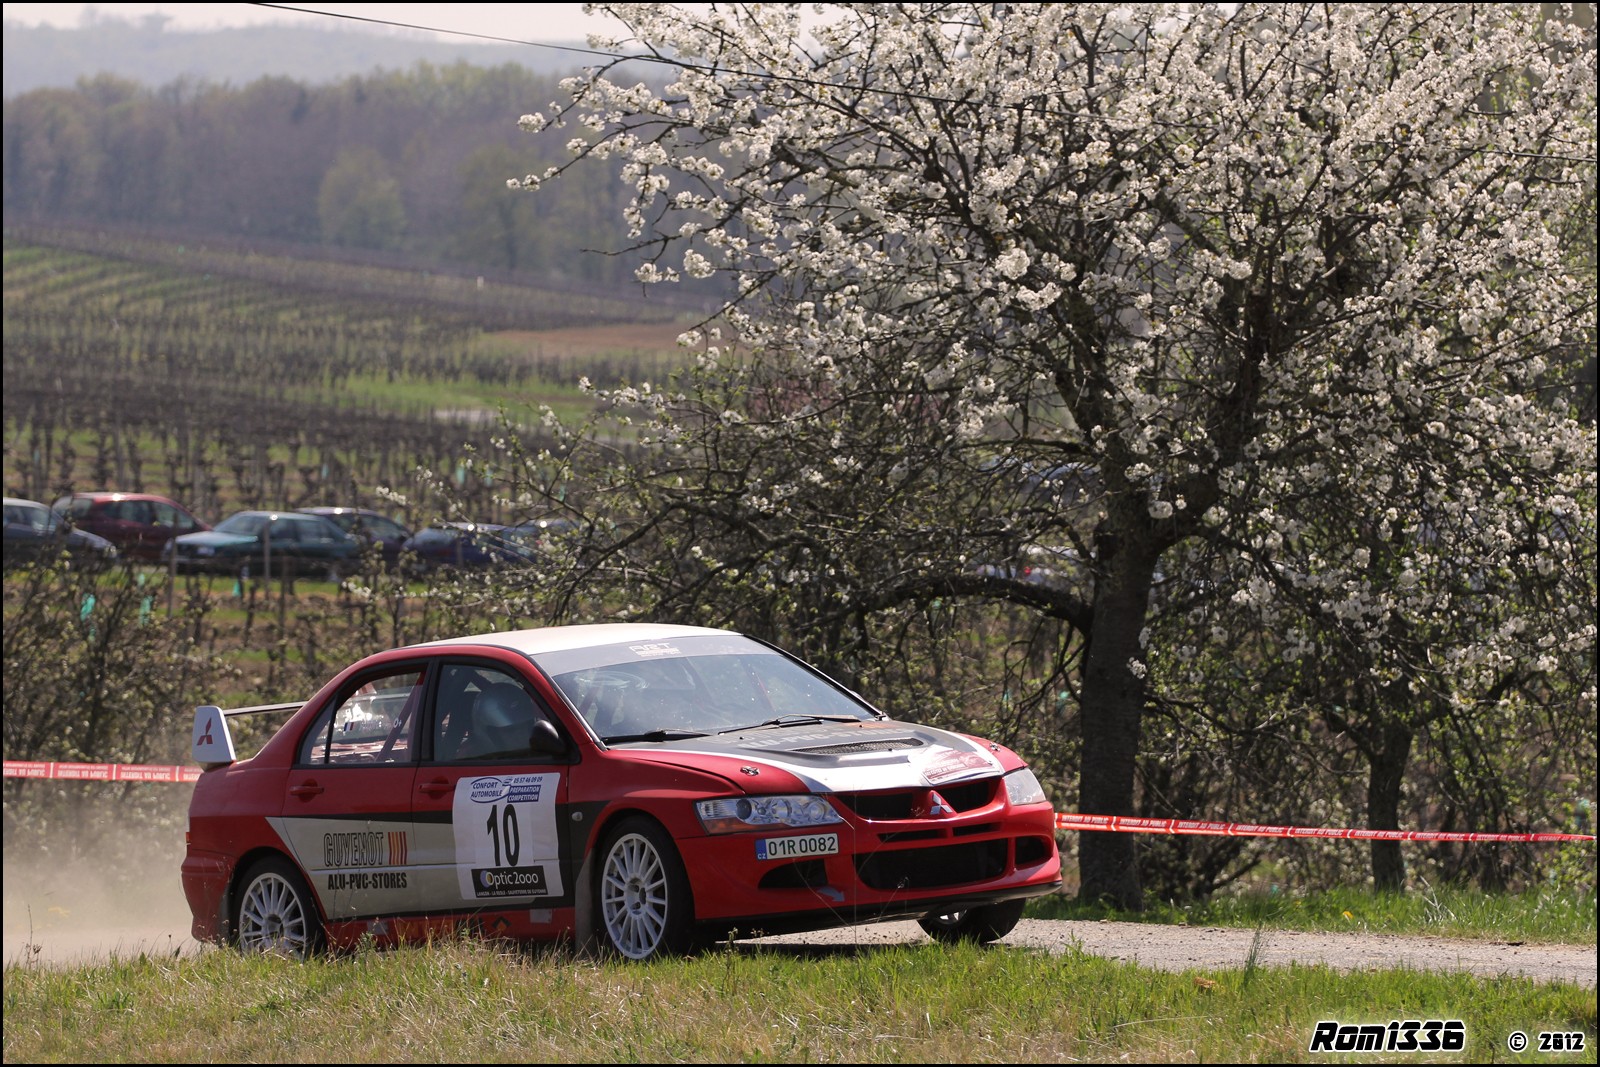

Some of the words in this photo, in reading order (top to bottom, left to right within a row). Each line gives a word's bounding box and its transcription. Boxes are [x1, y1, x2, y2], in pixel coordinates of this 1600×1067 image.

[471, 790, 502, 798] AUTOMOBILE
[487, 804, 520, 866] 10
[324, 832, 384, 866] GUYENOT
[800, 837, 836, 852] 0082
[328, 873, 407, 890] ALU-PVC-STORES
